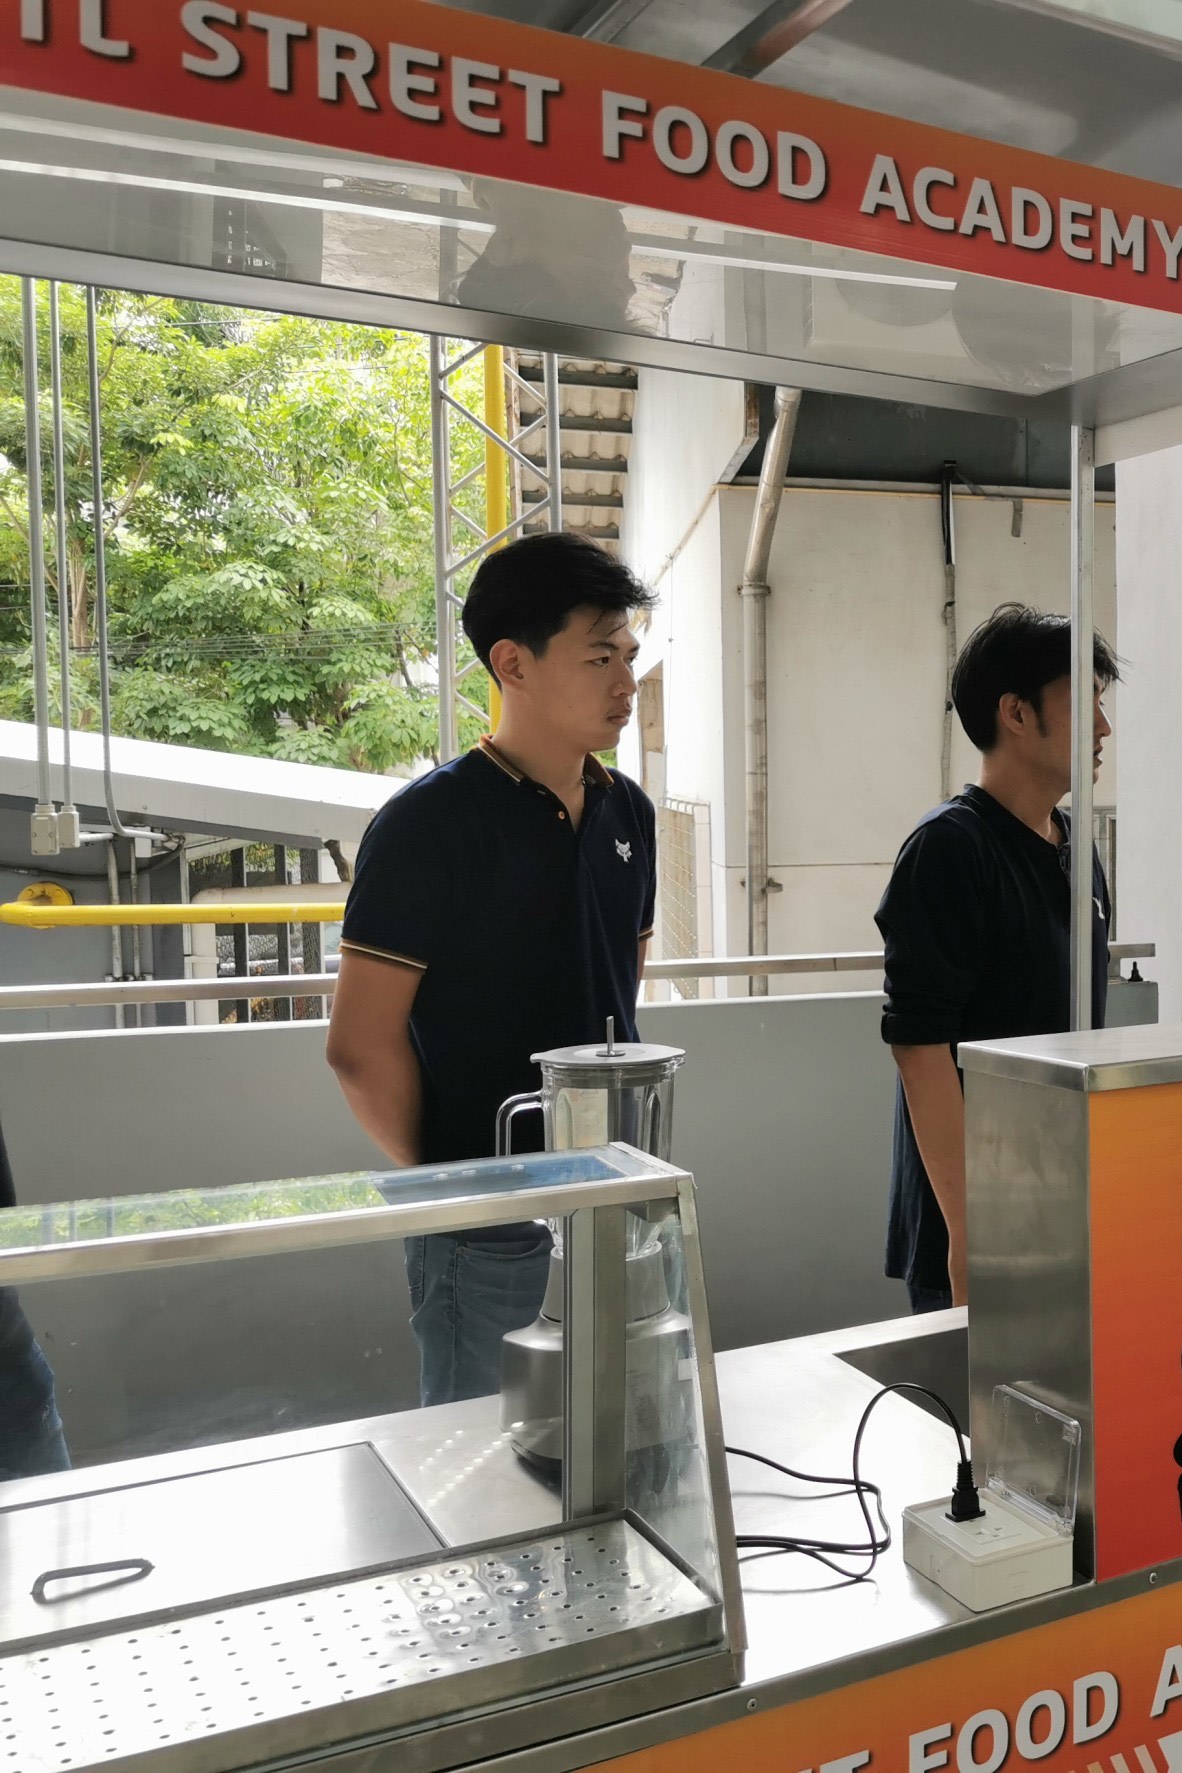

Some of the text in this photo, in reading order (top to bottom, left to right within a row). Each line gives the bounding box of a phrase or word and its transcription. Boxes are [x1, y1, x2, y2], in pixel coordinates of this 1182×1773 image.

[180, 0, 561, 143] STREET
[601, 90, 827, 201] FOOD
[908, 1670, 1120, 1773] FOOD
